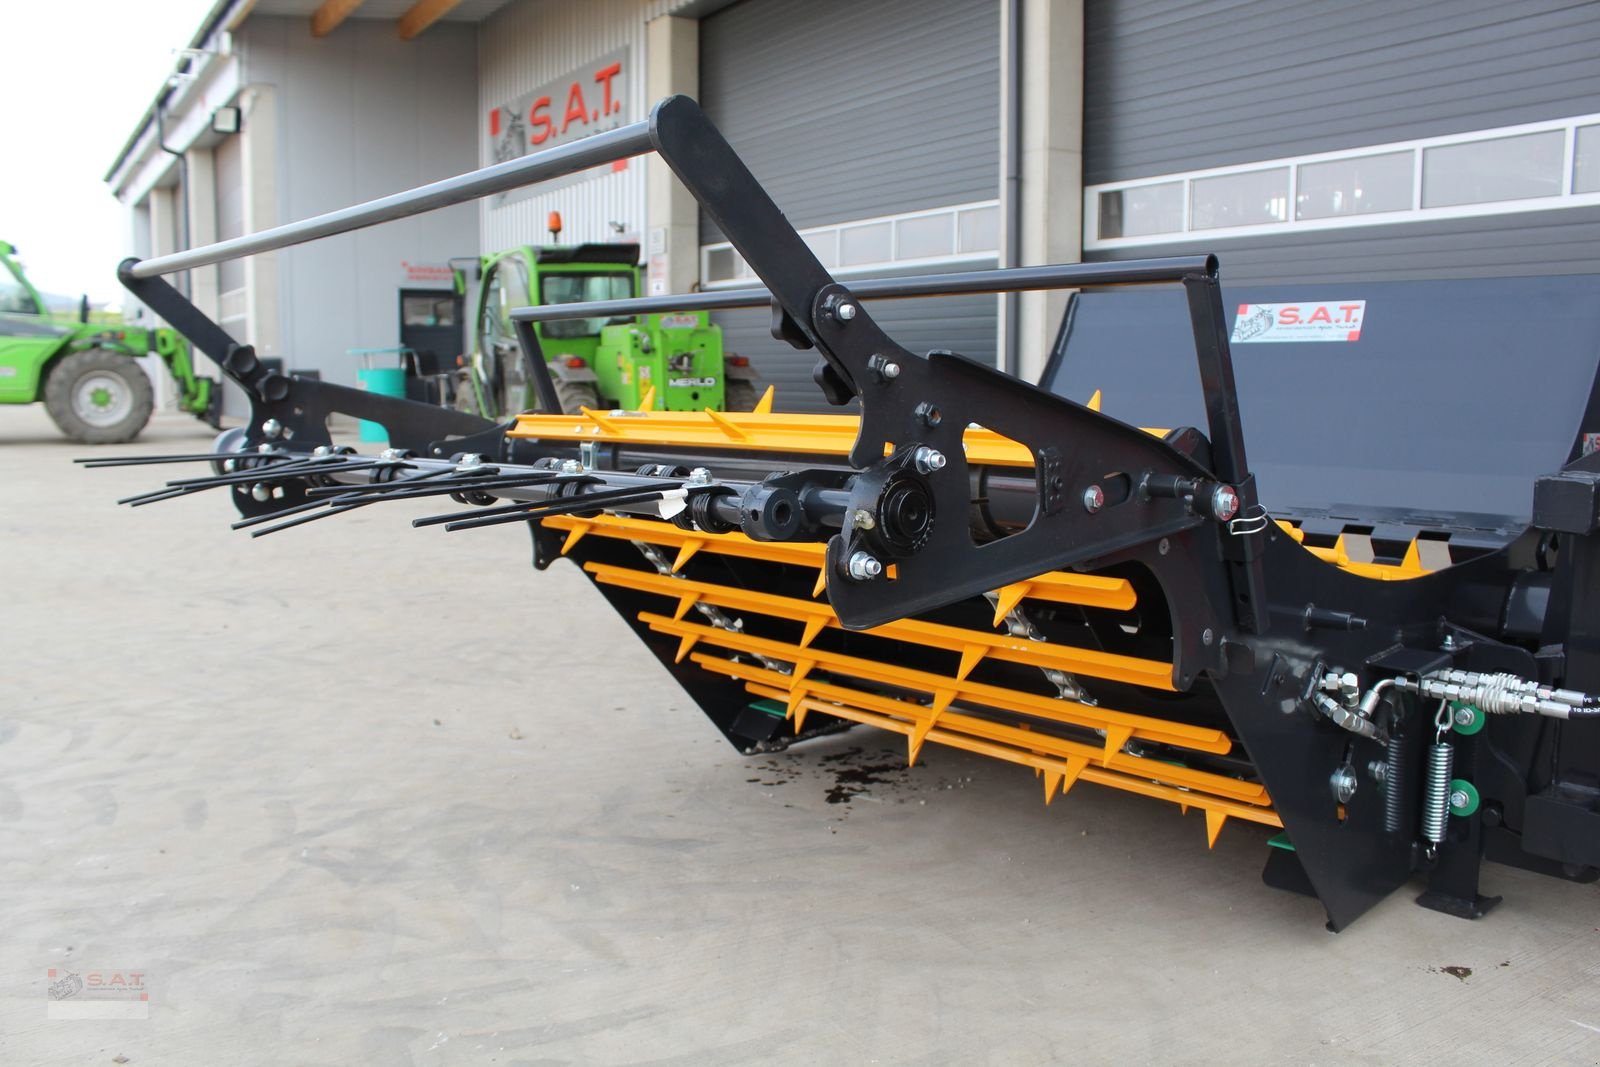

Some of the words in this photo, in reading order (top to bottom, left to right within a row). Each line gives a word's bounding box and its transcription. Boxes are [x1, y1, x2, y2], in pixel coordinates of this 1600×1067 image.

[529, 61, 621, 145] S.A.T.
[1278, 305, 1361, 325] S.A.T.
[668, 377, 716, 387] MERLO
